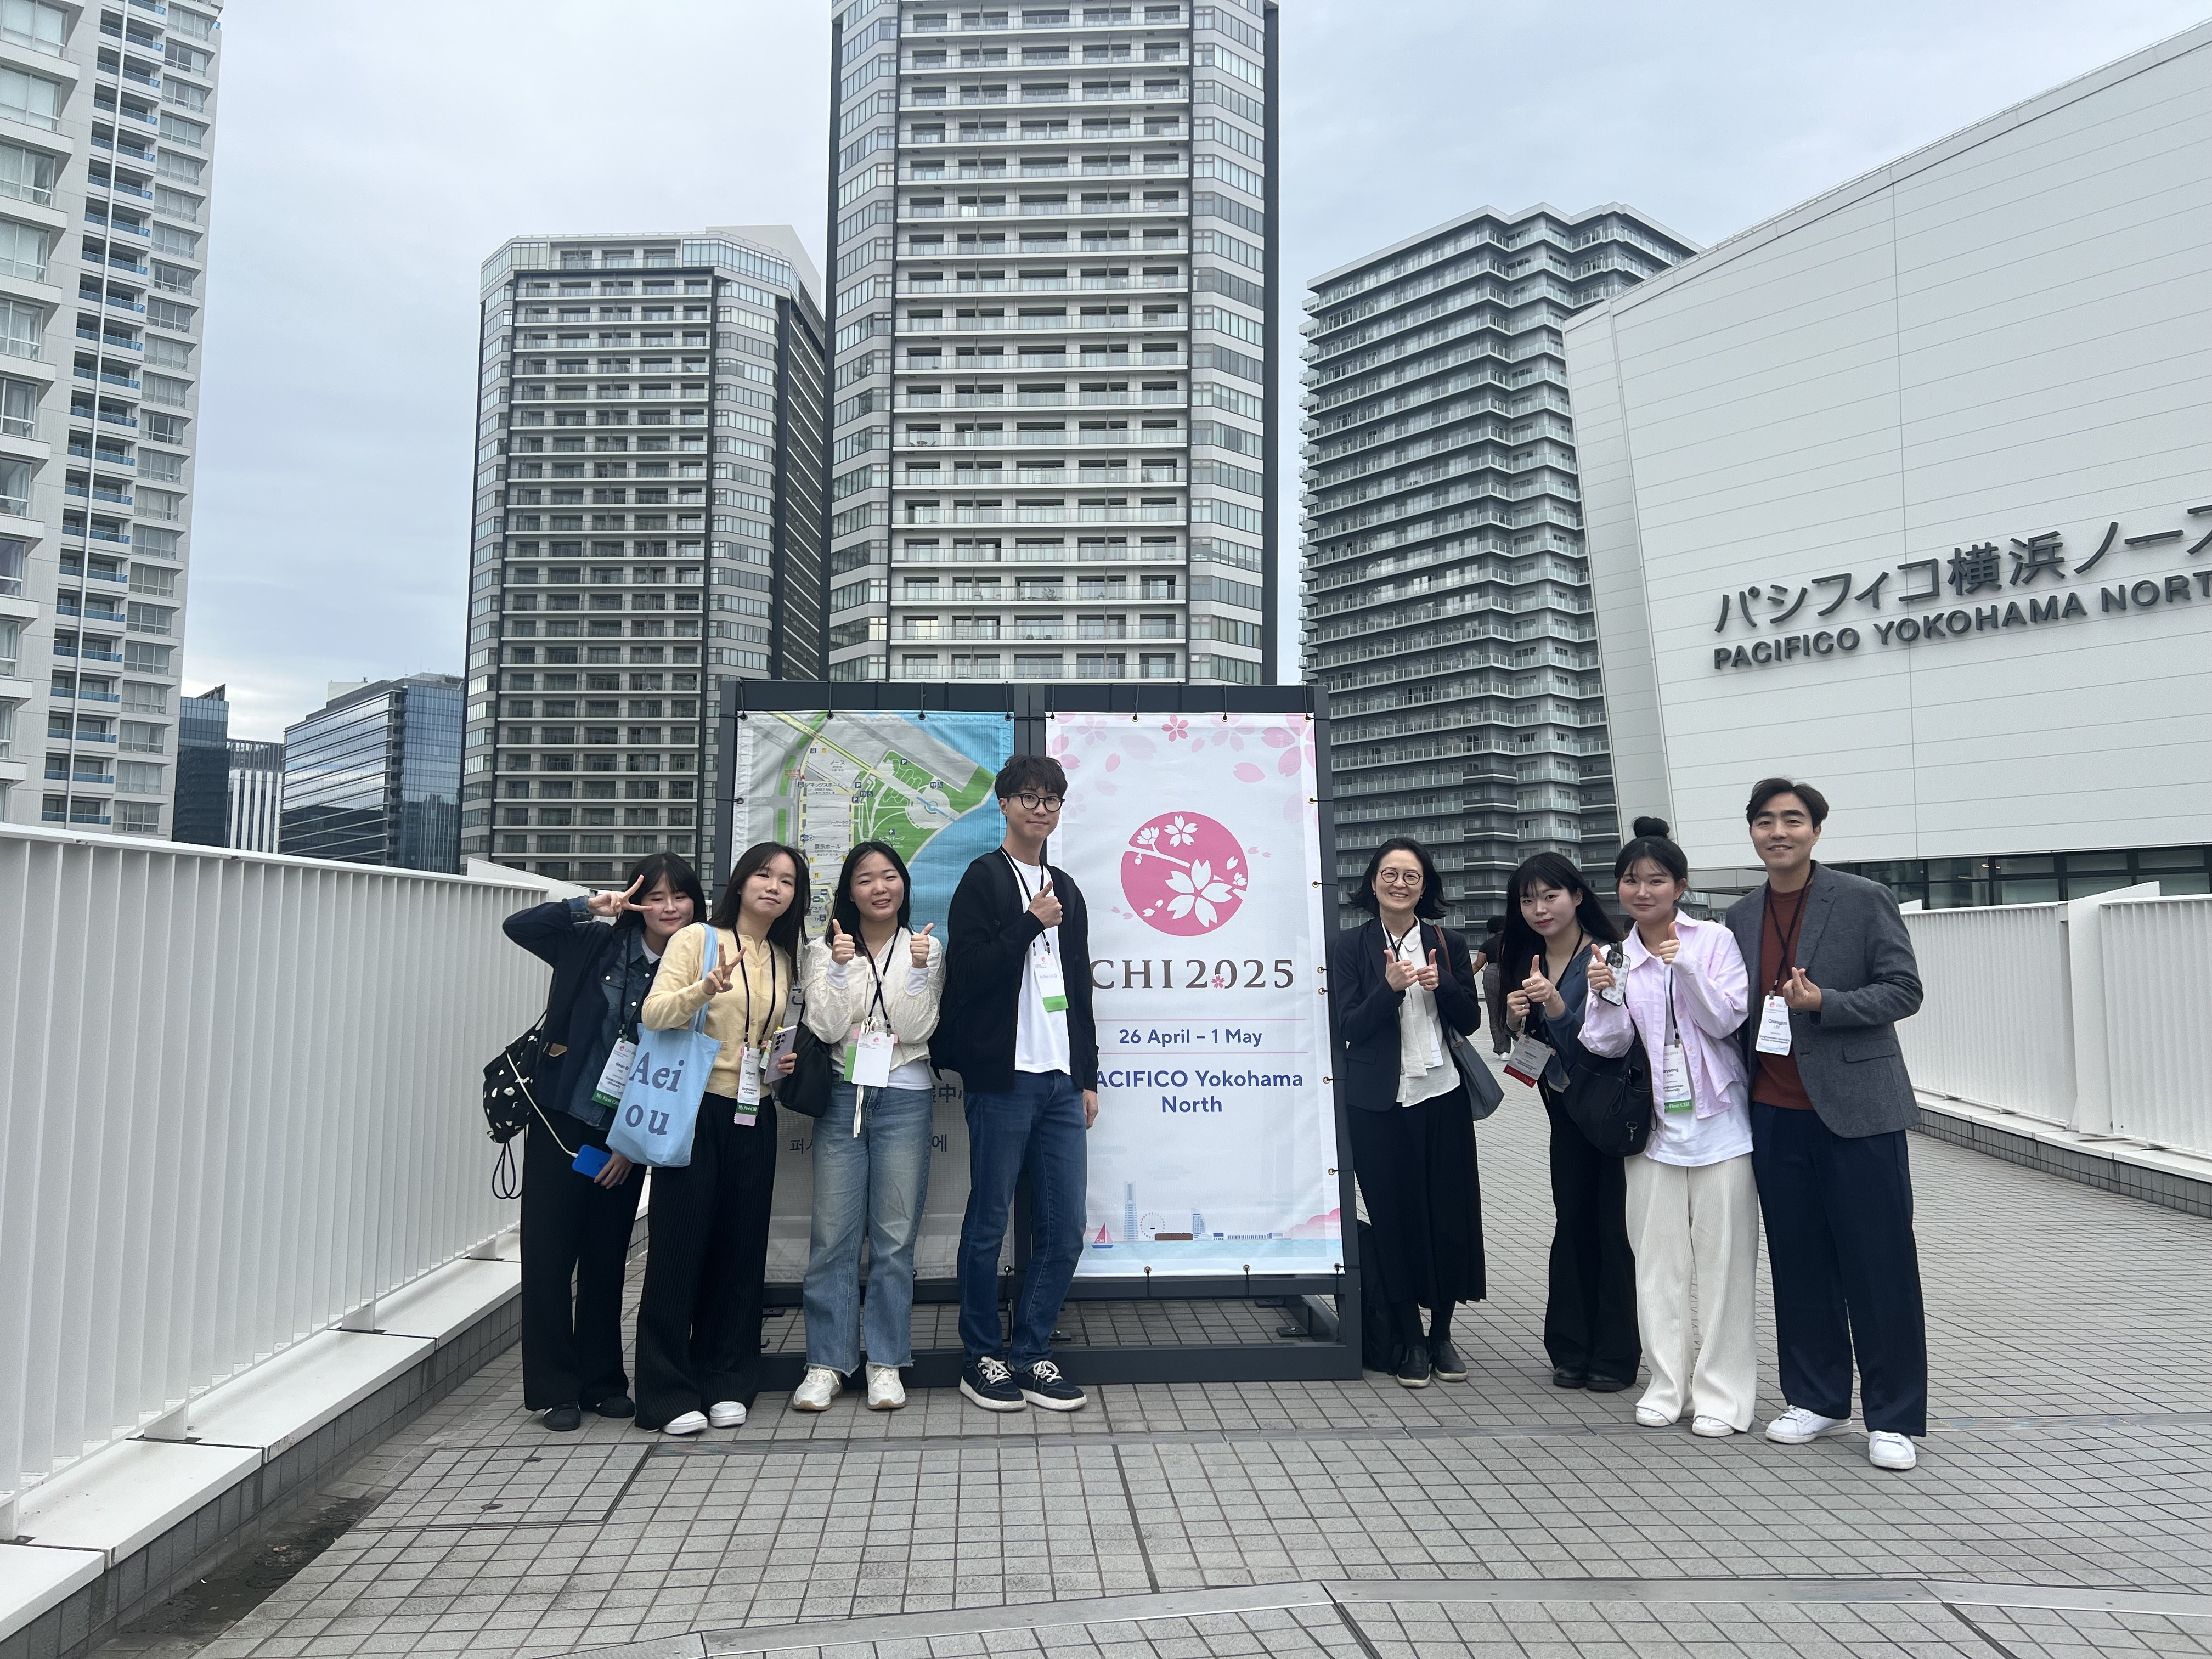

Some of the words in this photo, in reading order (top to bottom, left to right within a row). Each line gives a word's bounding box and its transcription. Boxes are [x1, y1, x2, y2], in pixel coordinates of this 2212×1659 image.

[1714, 627, 1860, 669] PACIFICO
[1873, 592, 2087, 645] YOKOHAMA
[2101, 570, 2212, 612] NORT
[1090, 960, 1173, 989] CHI
[1186, 959, 1294, 989] 2025
[1119, 1029, 1141, 1044] 26
[1147, 1029, 1190, 1047] April
[1211, 1029, 1218, 1043] 1
[1226, 1029, 1262, 1047] May
[629, 1052, 685, 1092] Aei
[1097, 1070, 1188, 1087] ACIFICO
[1195, 1070, 1303, 1087] Yokohama
[1162, 1096, 1222, 1113] North
